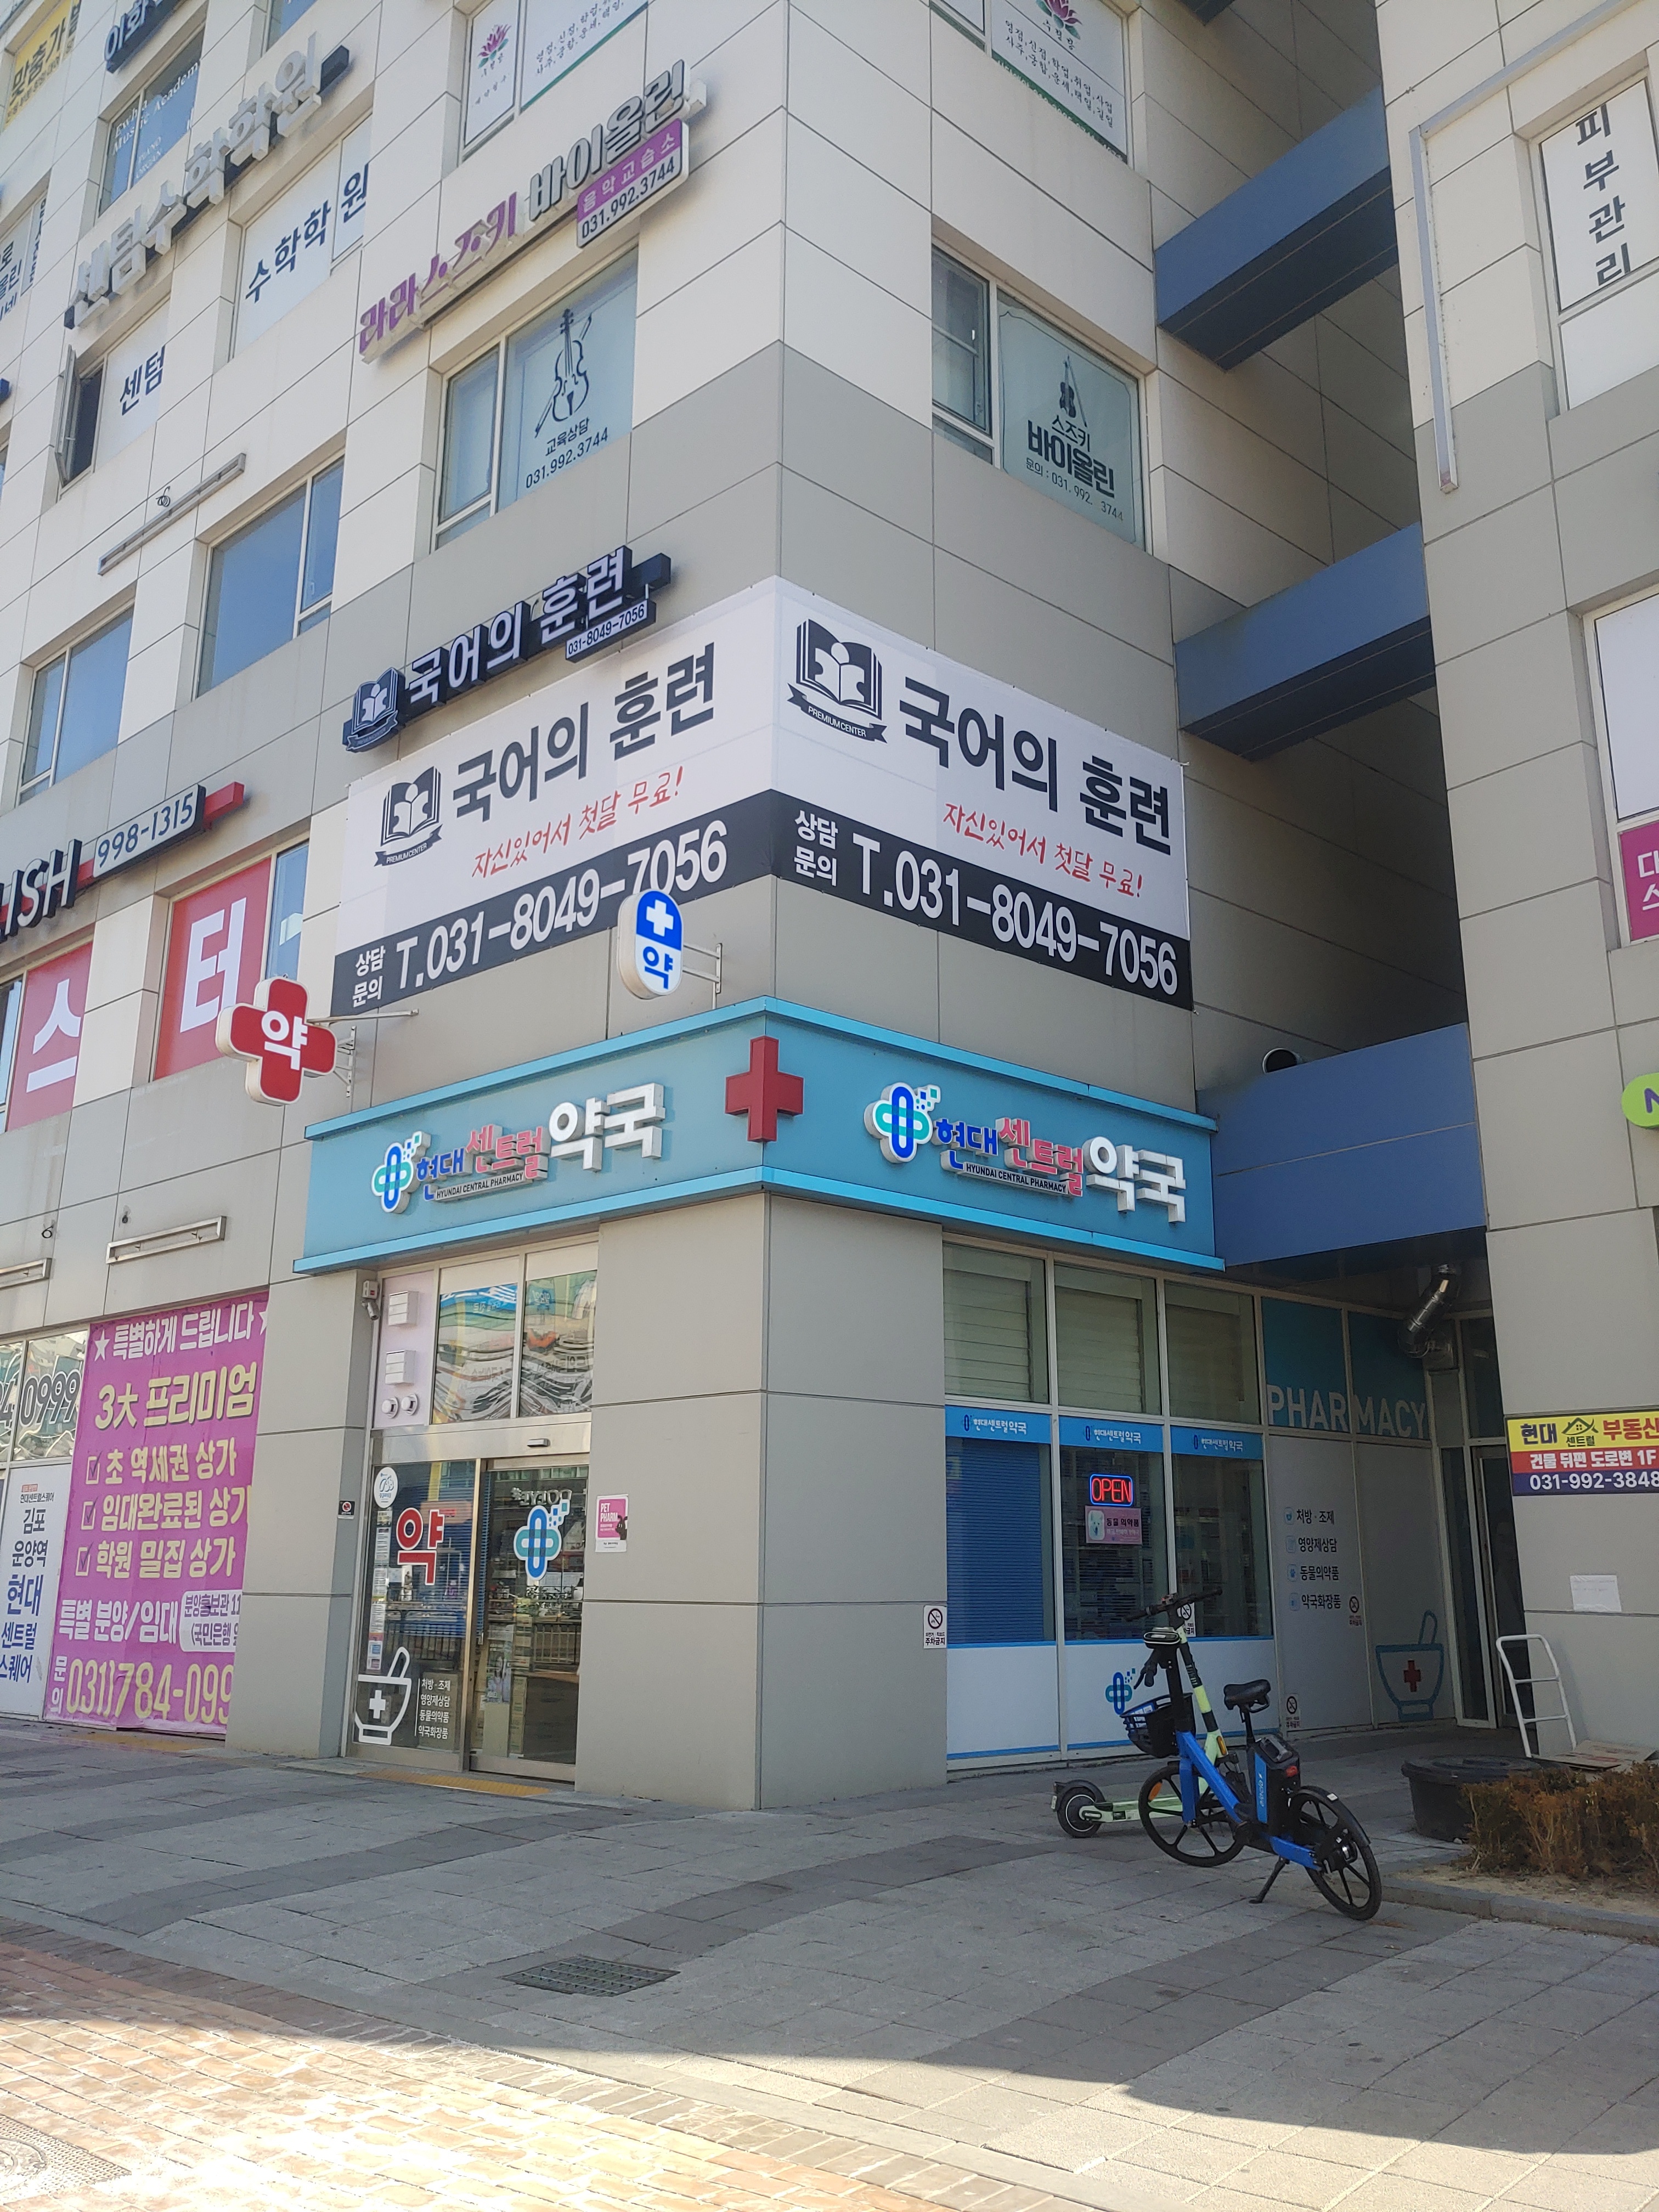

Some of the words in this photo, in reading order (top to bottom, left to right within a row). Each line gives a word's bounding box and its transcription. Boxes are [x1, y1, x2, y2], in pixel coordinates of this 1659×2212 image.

[528, 59, 686, 221] 바이올린
[582, 157, 676, 239] 031.992.3744
[1575, 104, 1632, 286] 피부관리
[245, 163, 369, 304] 수학학원
[120, 344, 166, 416] 센텀
[545, 417, 590, 456] 교육상담
[1051, 414, 1091, 452] 스즈키
[526, 427, 609, 489] 031.992.3744
[1027, 420, 1115, 499] 바이올린
[409, 603, 523, 706] 국어의
[540, 547, 627, 642] 훈련
[567, 602, 646, 656] 031-8049-7056
[453, 703, 589, 823] 국어의
[610, 641, 715, 761] 훈련
[808, 705, 840, 729] PREMIUM
[840, 722, 867, 738] CENTER
[899, 675, 1058, 813] 국어의
[1079, 755, 1171, 855] 훈련
[98, 791, 194, 867] 998-1315
[472, 814, 572, 878] 자신있어서
[578, 790, 621, 840] 첫달
[628, 765, 684, 814] 무료!
[794, 809, 839, 850] 상담
[386, 851, 410, 864] PREMIUM
[408, 842, 428, 857] CENTER
[794, 845, 838, 887] 문의
[942, 802, 1047, 865] 자신있어서
[1053, 843, 1094, 883] 첫달
[1098, 860, 1143, 899] 무료!
[396, 819, 728, 990] T.031-8049-7056
[852, 832, 1178, 996] T.031-8049-7056
[355, 945, 386, 975] 상담
[642, 946, 674, 990] 약
[352, 974, 383, 1006] 문의
[261, 1010, 308, 1071] 약
[437, 1184, 462, 1199] HYUNDAI
[463, 1181, 489, 1193] CENTRAL
[490, 1172, 524, 1188] PHARMACY
[966, 1163, 997, 1178] HYUNDAI
[998, 1170, 1029, 1186] CENTRAL
[1030, 1177, 1066, 1193] PHARMACY
[112, 1314, 178, 1361] 특별하게
[179, 1300, 254, 1351] 드립니다
[19, 1368, 82, 1427] 0999
[143, 1361, 257, 1427] 프리미엄
[1266, 1384, 1426, 1440] PHARMACY
[1520, 1423, 1558, 1446] 현대
[1565, 1435, 1596, 1448] 센트럴
[105, 1448, 123, 1485] 초
[131, 1443, 190, 1484] 역세권
[195, 1437, 238, 1480] 상가
[1530, 1453, 1557, 1470] 건물
[1560, 1452, 1587, 1469] 뒤편
[1590, 1450, 1633, 1468] 도로변
[1637, 1449, 1656, 1465] 1F
[100, 1489, 202, 1532] 임대완료된
[600, 1503, 611, 1513] PET
[1092, 1478, 1131, 1502] OPEN
[23, 1508, 46, 1534] 김포
[1106, 1518, 1119, 1527] 동물
[1120, 1518, 1139, 1527] 의약품
[1296, 1509, 1313, 1524] 처방
[1318, 1510, 1335, 1525] 조제
[12, 1539, 49, 1568] 운양역
[96, 1540, 133, 1579] 학원
[139, 1539, 186, 1579] 밀집
[189, 1536, 236, 1578] 상가
[396, 1508, 445, 1586] 약
[1297, 1537, 1338, 1553] 영양제상담
[1299, 1565, 1340, 1581] 동물의약품
[6, 1574, 43, 1617] 현대
[184, 1594, 230, 1618] 분양홍보관
[1301, 1594, 1341, 1610] 약국화장품
[0, 1622, 37, 1651] 센트럴
[58, 1599, 93, 1641] 특별
[93, 1599, 179, 1645] 분양/임대
[925, 1637, 945, 1646] 주차금지
[420, 1694, 450, 1707] 영양제상담
[421, 1678, 434, 1690] 처방
[438, 1680, 451, 1691] 조제
[418, 1725, 448, 1740] 약국화장품
[419, 1709, 449, 1723] 동물의약품
